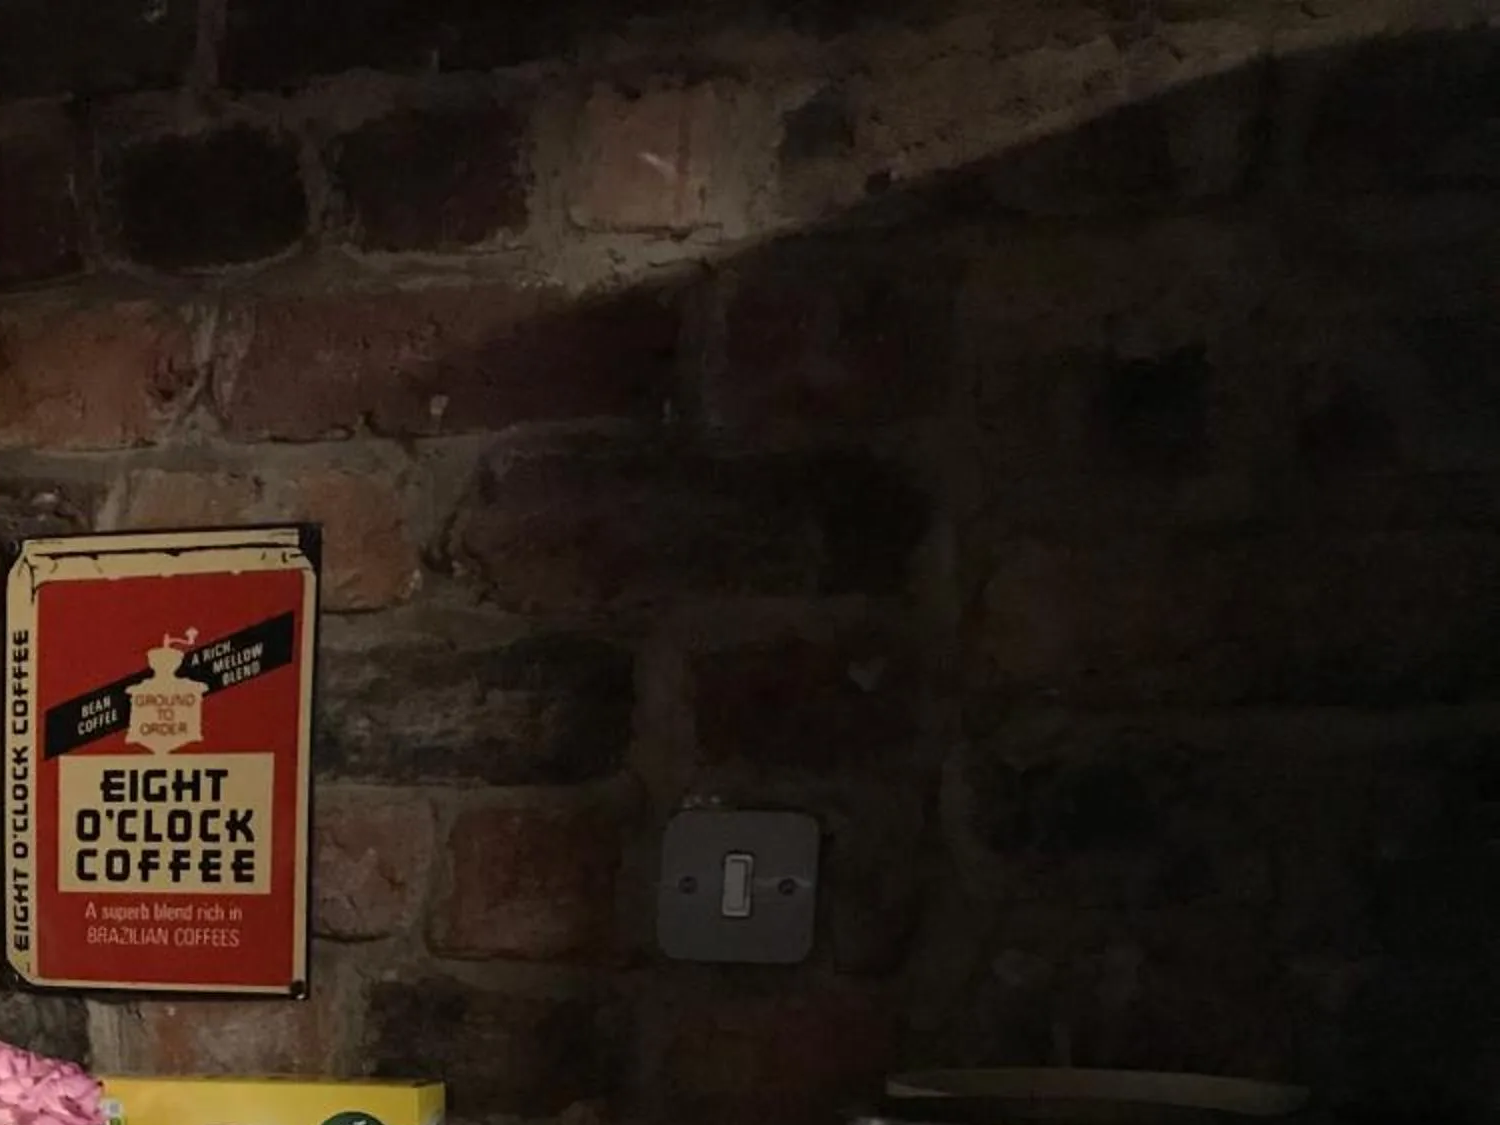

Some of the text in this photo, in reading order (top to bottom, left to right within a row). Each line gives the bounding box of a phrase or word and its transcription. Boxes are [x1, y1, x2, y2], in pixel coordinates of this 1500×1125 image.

[191, 653, 200, 667] A
[213, 643, 264, 674] MELLOW
[222, 663, 261, 686] BLEND
[81, 696, 112, 718] BEAN
[134, 693, 196, 707] GROUND
[77, 708, 118, 736] COFFEE
[157, 708, 174, 722] TO
[139, 722, 188, 736] ORDER
[12, 629, 29, 951] EIGHT O'CLOCK COFFEE
[101, 769, 229, 803] EIGHT
[76, 809, 256, 843] O'CLOCK
[76, 849, 256, 884] COFFEE
[85, 901, 243, 923] A superb blend rich in
[86, 926, 241, 948] BRAZILIAN COFFEES
